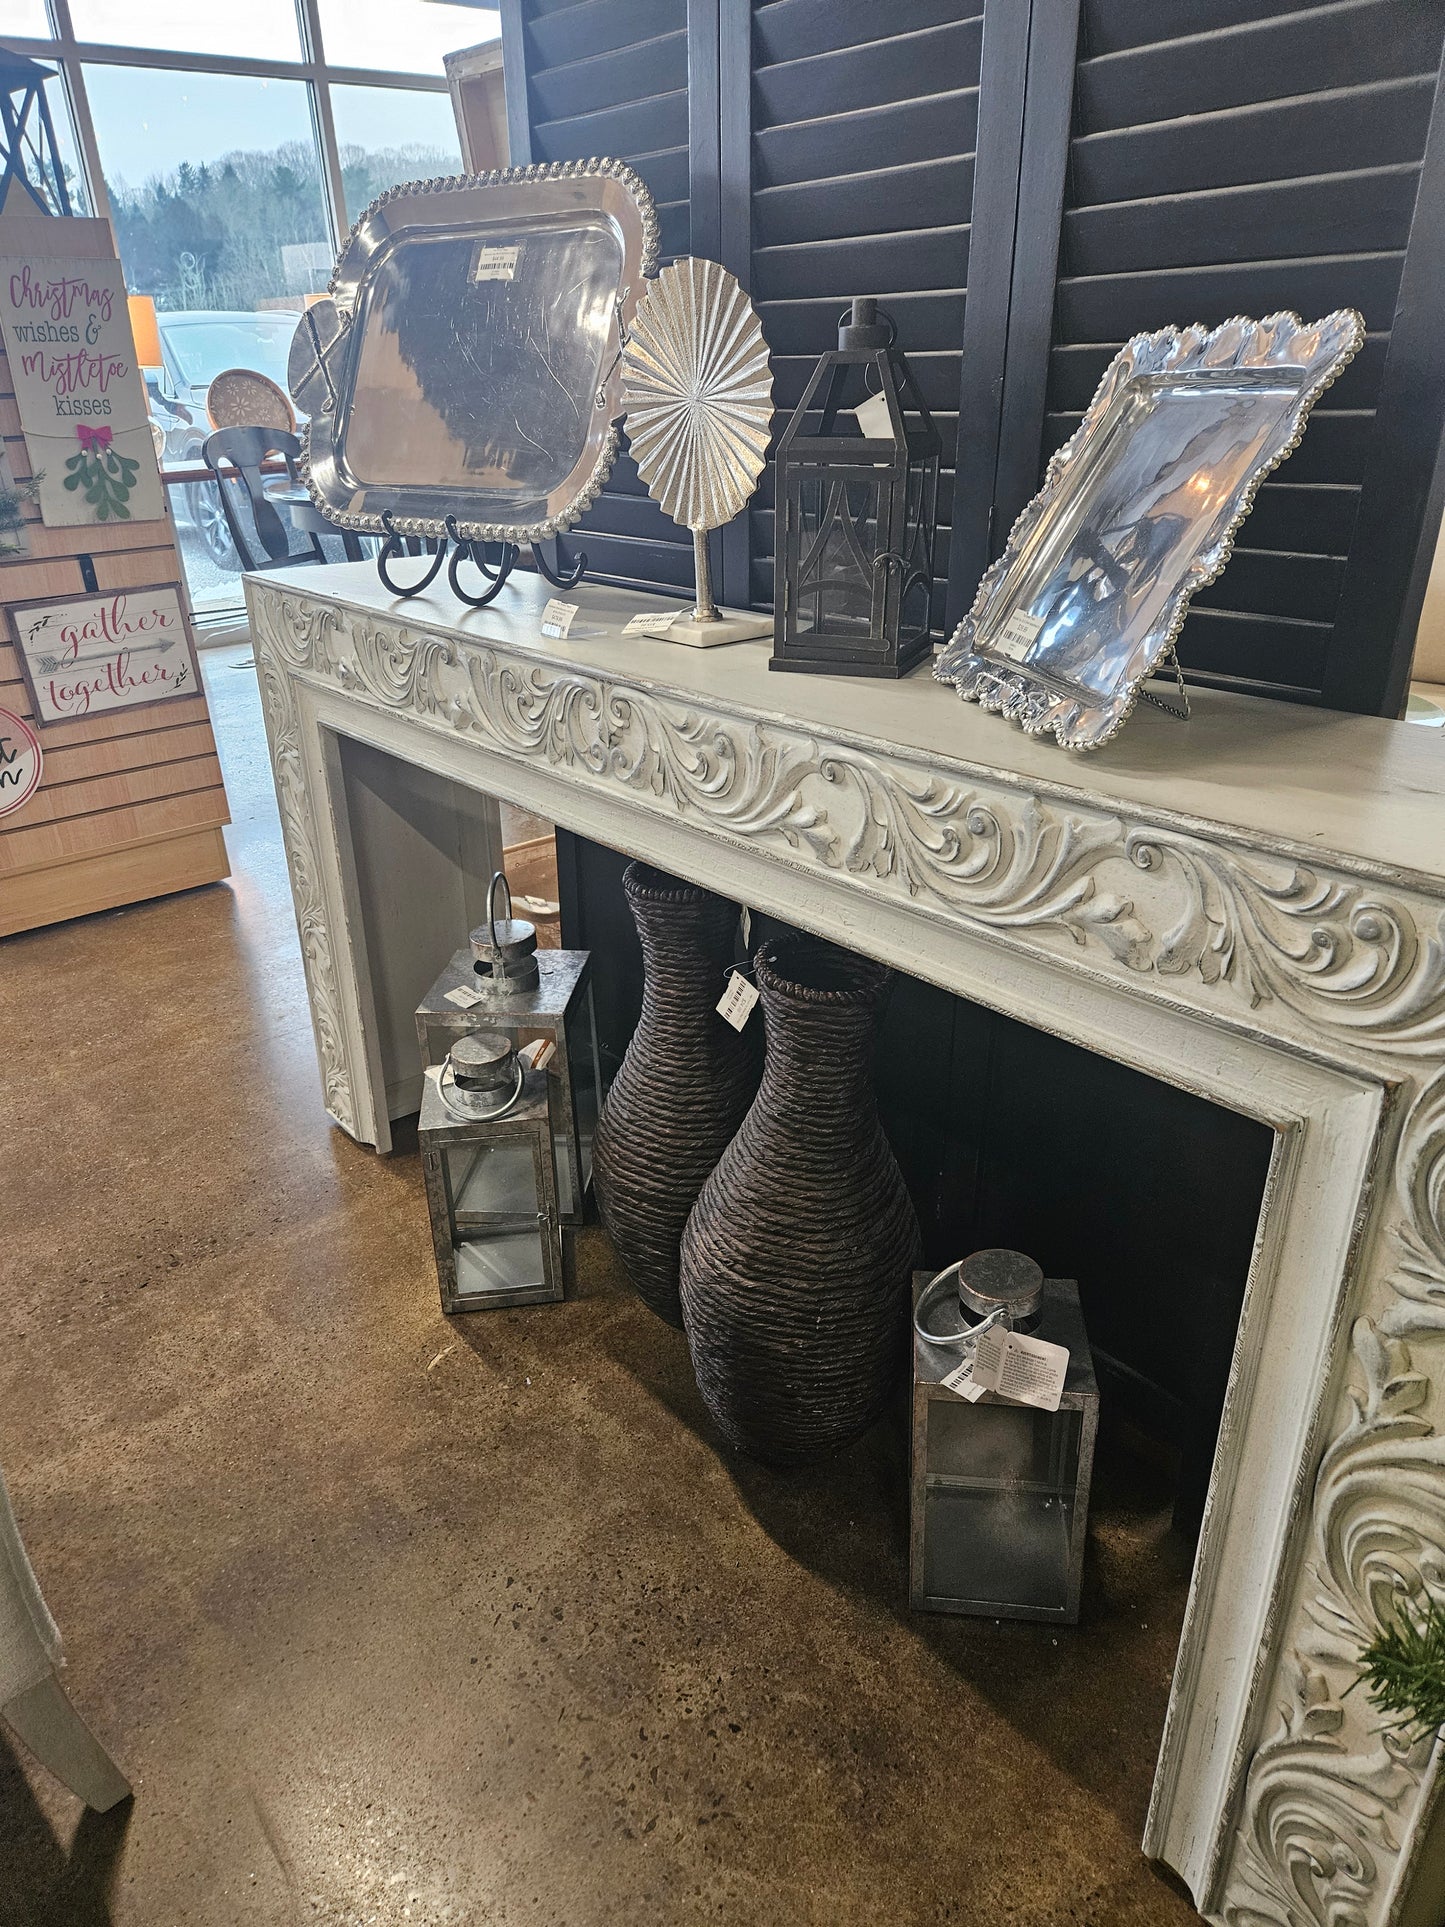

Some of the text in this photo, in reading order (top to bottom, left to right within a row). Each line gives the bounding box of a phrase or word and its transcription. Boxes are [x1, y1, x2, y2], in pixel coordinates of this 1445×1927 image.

[9, 265, 115, 322] Christmas
[12, 313, 102, 345] wishes &
[21, 348, 129, 396] Mistletoe
[52, 395, 112, 416] kisses
[60, 594, 175, 669] gather
[42, 647, 175, 715] together
